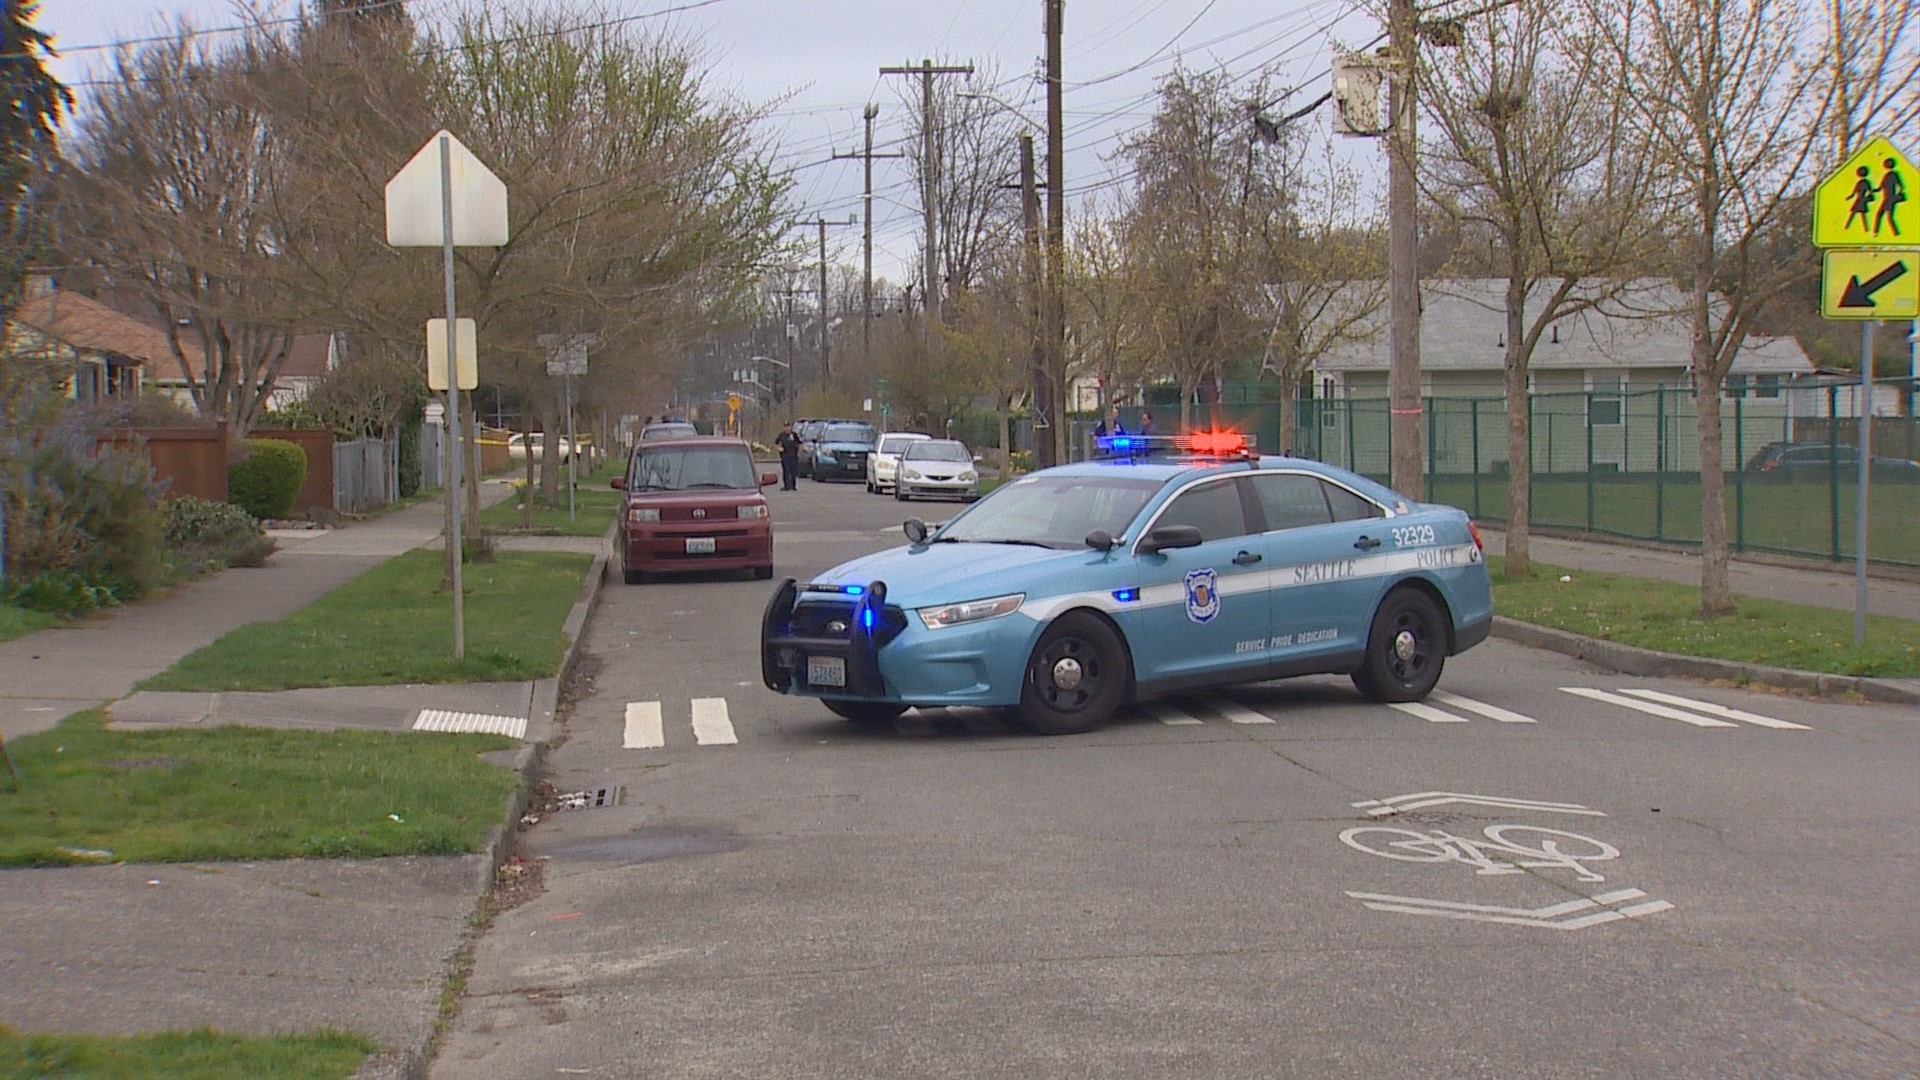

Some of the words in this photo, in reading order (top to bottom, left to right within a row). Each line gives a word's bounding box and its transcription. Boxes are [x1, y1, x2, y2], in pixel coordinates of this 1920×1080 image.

[1391, 524, 1436, 546] 32329
[1294, 560, 1356, 583] SEATTLE
[1417, 548, 1457, 567] POLICE
[1235, 639, 1266, 653] SERVICE
[1270, 634, 1292, 647] PRIDE
[1297, 628, 1338, 644] DEDICATION
